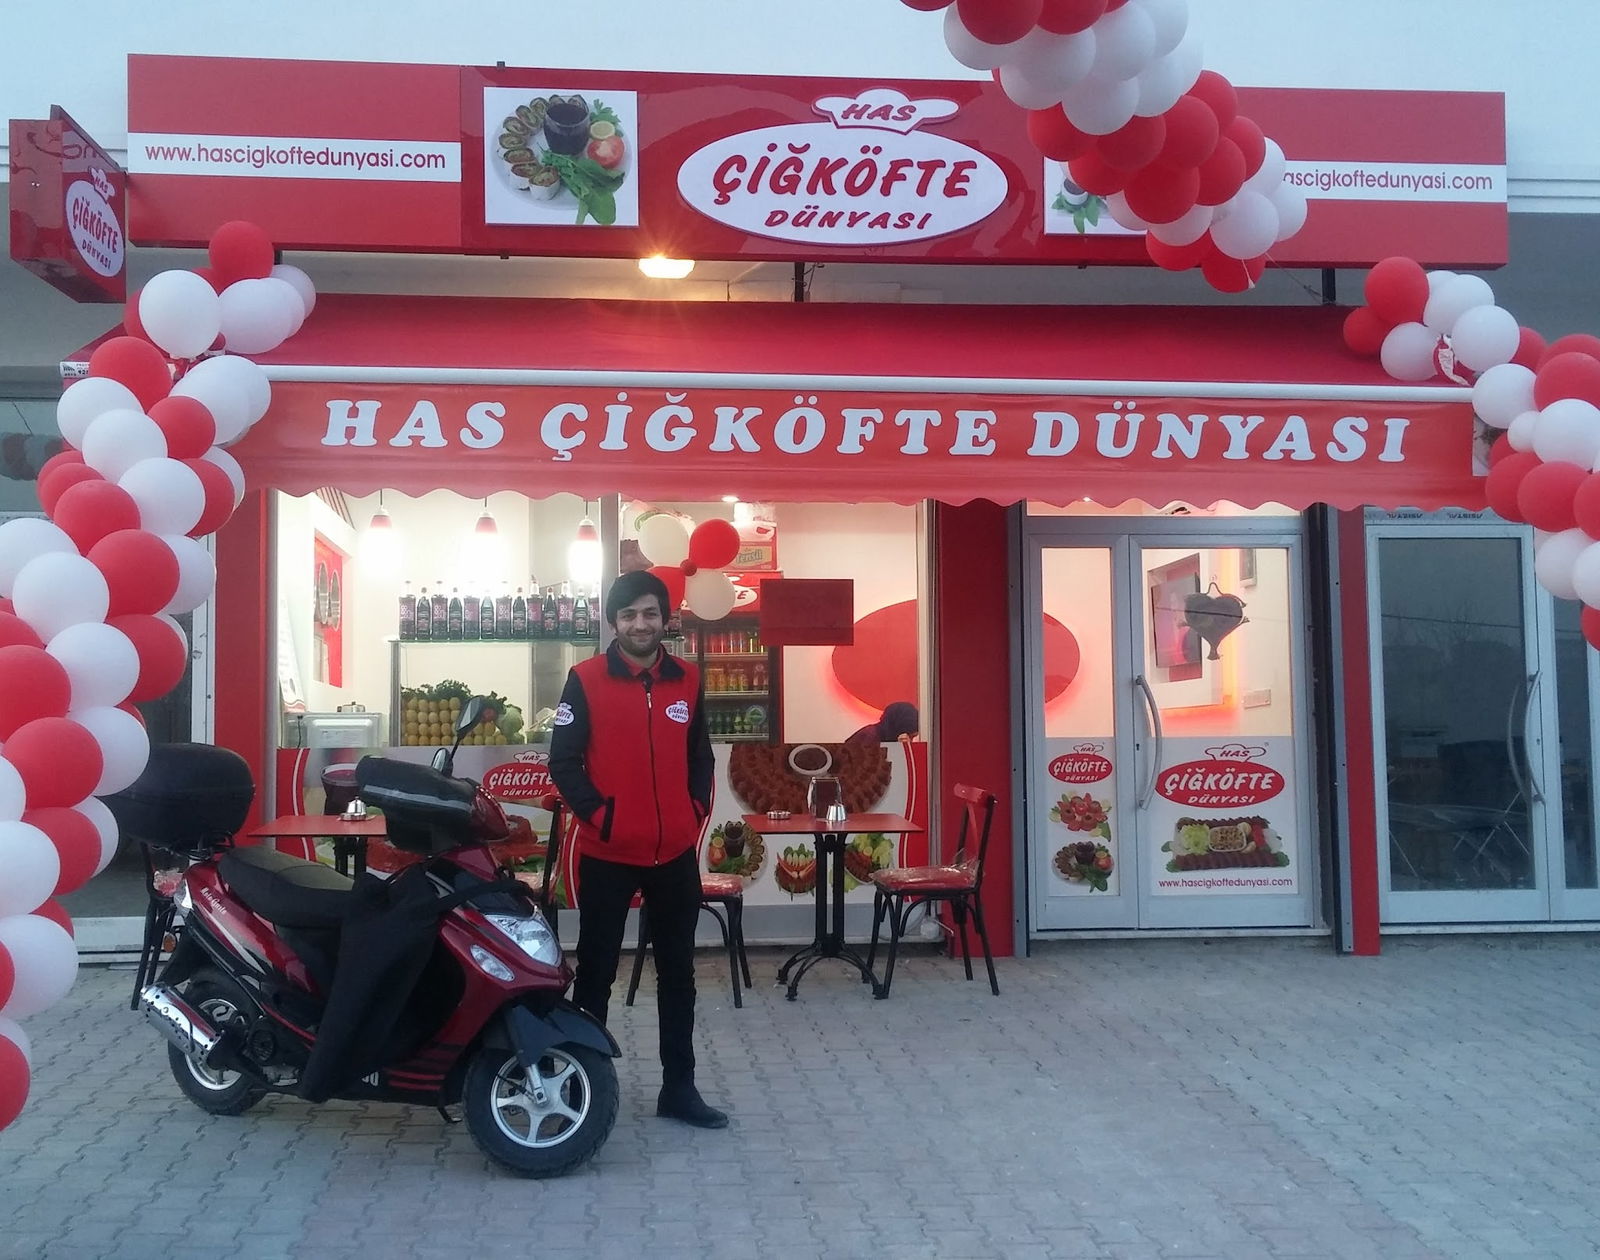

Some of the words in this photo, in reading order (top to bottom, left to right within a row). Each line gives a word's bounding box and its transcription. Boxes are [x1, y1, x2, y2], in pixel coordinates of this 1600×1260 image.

[840, 103, 917, 122] HAS
[145, 143, 447, 171] www.hascigkoftedunyasi.com
[712, 142, 978, 206] ÇİĞKÖFTE
[1283, 169, 1493, 193] ascigkoftedunyasi.com
[72, 196, 119, 254] ÇİĞKÖFTE
[764, 204, 933, 230] DÜNYASI
[320, 399, 506, 449] HAS
[540, 391, 997, 462] ÇİĞKÖFTE
[1026, 400, 1411, 463] DÜNYASI
[1220, 749, 1250, 757] HAS
[1053, 757, 1109, 777] ÇİĞKÖFTE
[502, 787, 543, 796] DÜNYASI
[1164, 767, 1276, 796] ÇİĞKÖFTE
[1187, 794, 1256, 804] DÜNYASI
[1158, 877, 1294, 890] www.hascigkoftedunyasi.com
